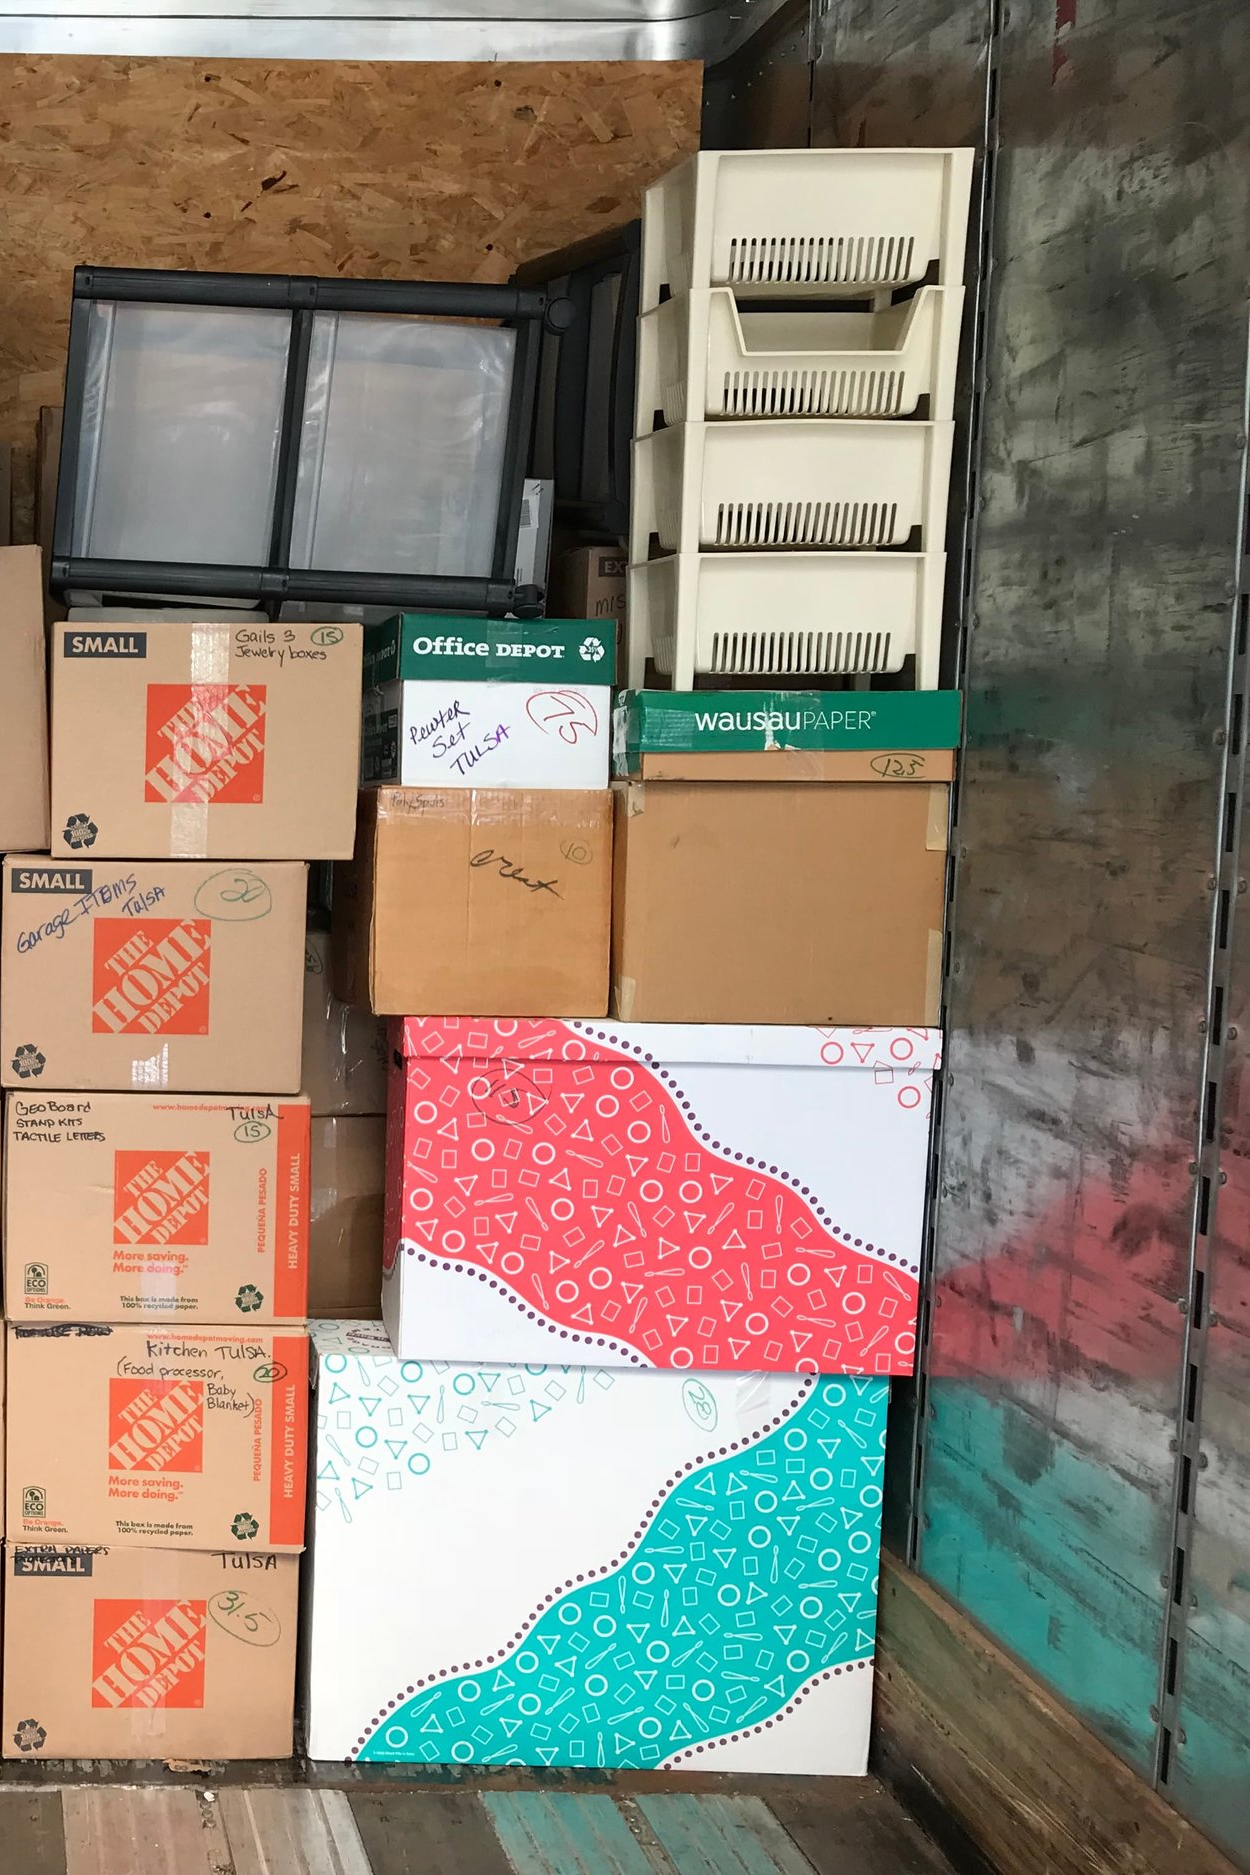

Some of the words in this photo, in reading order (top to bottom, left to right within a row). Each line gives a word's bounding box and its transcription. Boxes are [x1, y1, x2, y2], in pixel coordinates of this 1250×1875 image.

[72, 635, 139, 653] SMALL
[283, 630, 296, 642] 3
[234, 645, 286, 667] Jewelry
[290, 645, 328, 661] boxes
[412, 636, 489, 657] Office
[495, 642, 566, 659] DEPOT
[432, 721, 471, 759] Set
[450, 724, 510, 775] TULSA
[19, 872, 85, 890] SMALL
[289, 1153, 301, 1193] SMALL
[258, 1168, 268, 1205] PESADO
[288, 1194, 300, 1228] DUTY
[113, 1250, 144, 1260] More
[147, 1250, 189, 1264] saving.
[287, 1229, 299, 1270] HEAVY
[113, 1263, 143, 1273] More
[147, 1263, 184, 1276] doing.
[26, 1279, 47, 1288] ECO
[146, 1340, 208, 1358] Kitchen
[159, 1362, 224, 1382] processor,
[207, 1383, 237, 1400] Baby
[118, 1388, 159, 1425] THE
[285, 1385, 296, 1423] SMALL
[109, 1380, 204, 1471] HOME
[253, 1398, 263, 1435] PESADO
[145, 1415, 203, 1472] DEPOT
[284, 1425, 295, 1458] DUTY
[109, 1476, 140, 1487] More
[142, 1477, 183, 1490] saving.
[283, 1460, 294, 1498] HEAVY
[109, 1488, 140, 1499] More
[142, 1489, 179, 1502] doing.
[139, 1528, 168, 1536] recycled
[169, 1529, 193, 1537] paper.
[21, 1556, 85, 1572] SMALL
